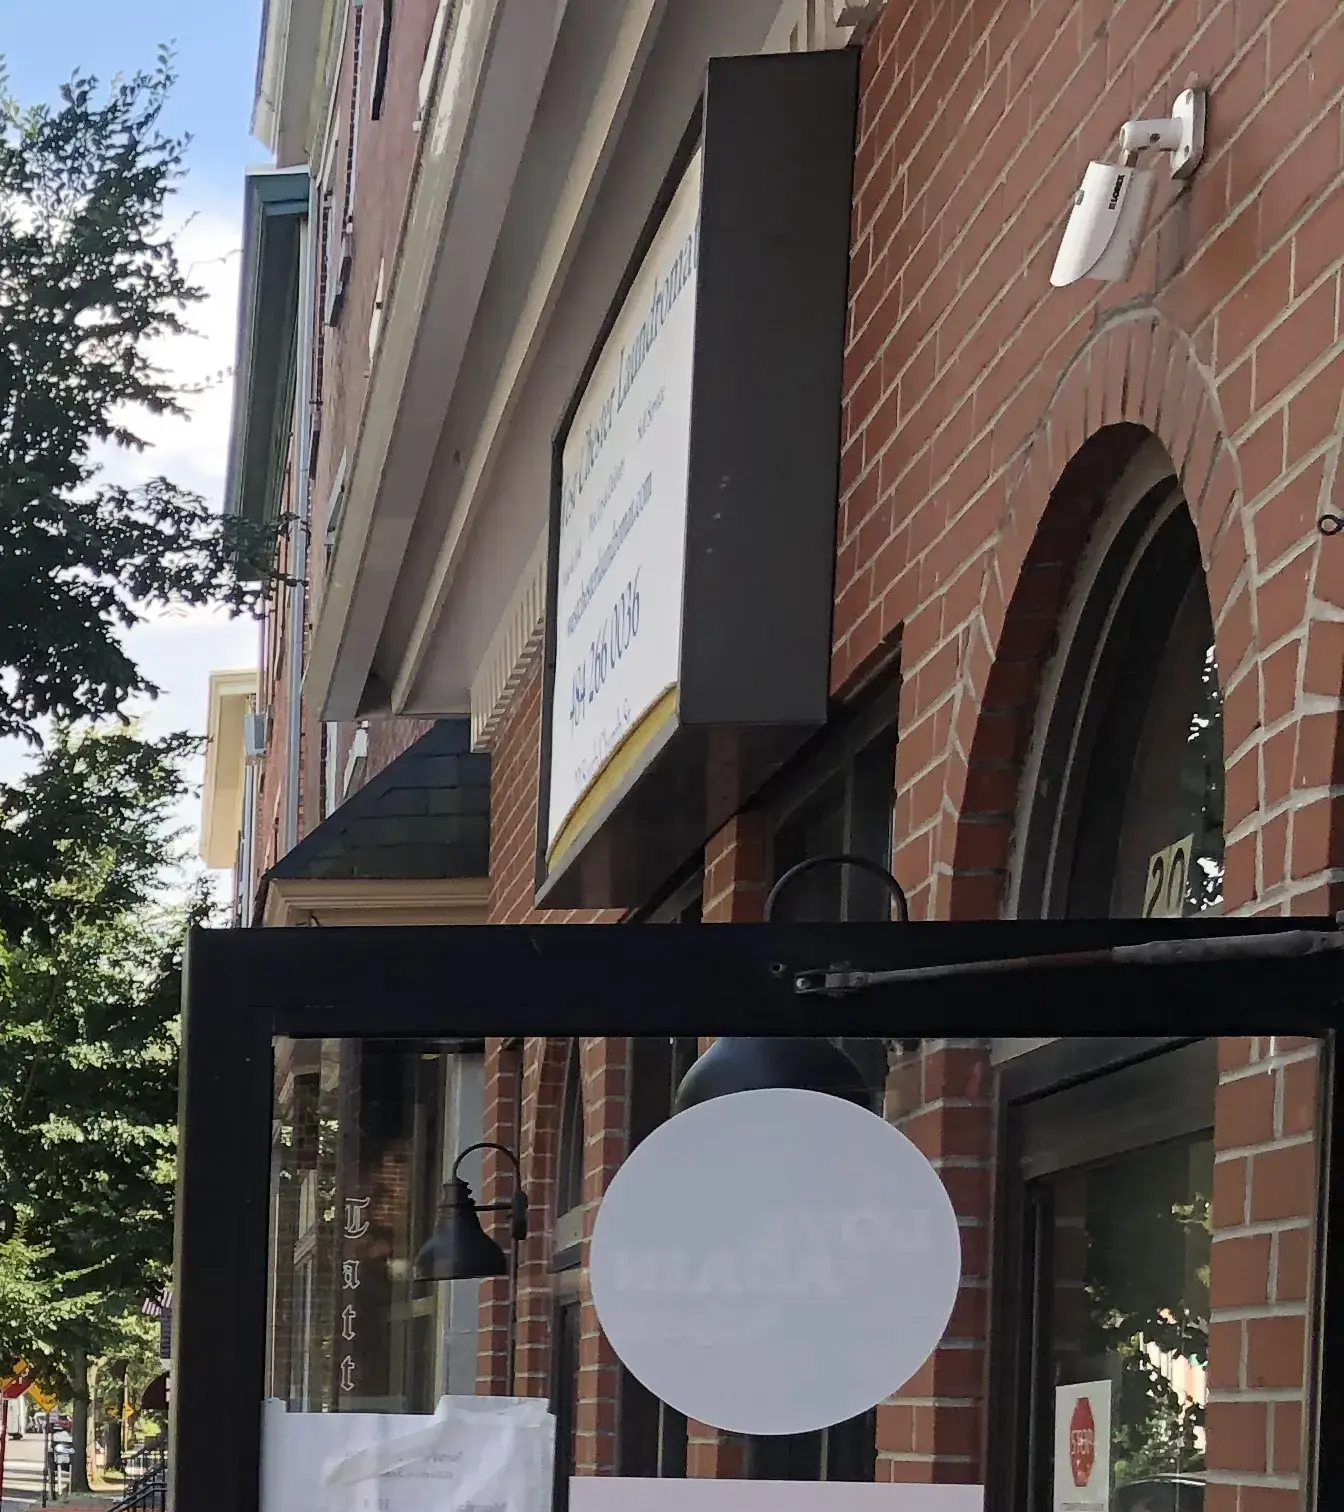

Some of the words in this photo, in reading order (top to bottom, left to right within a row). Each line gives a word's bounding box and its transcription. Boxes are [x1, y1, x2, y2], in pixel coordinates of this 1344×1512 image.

[589, 618, 607, 703] 266
[611, 564, 641, 669] 0036
[1145, 846, 1185, 918] 20
